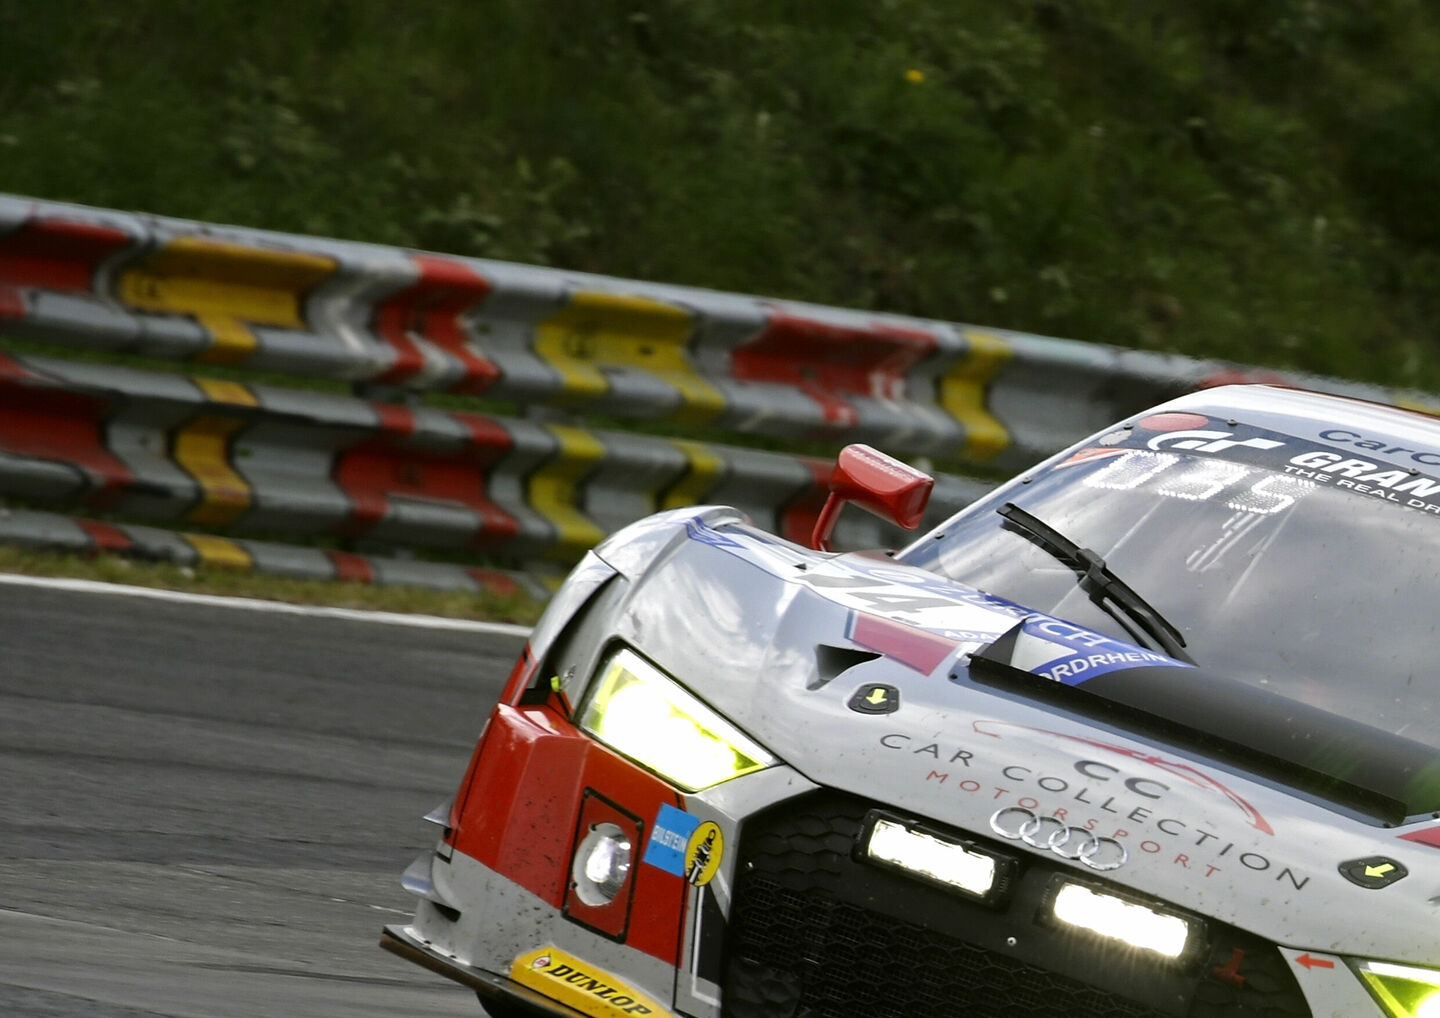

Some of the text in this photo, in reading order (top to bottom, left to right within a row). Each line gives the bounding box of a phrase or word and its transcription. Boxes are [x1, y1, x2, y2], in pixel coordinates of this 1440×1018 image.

[1283, 465, 1333, 482] THE
[1336, 479, 1400, 503] REAL
[879, 733, 1310, 890] CAR COLLECTION
[925, 769, 1222, 878] MOTORSPORT
[651, 824, 689, 854] BILSTEIN
[547, 963, 653, 1016] DUNLOP
